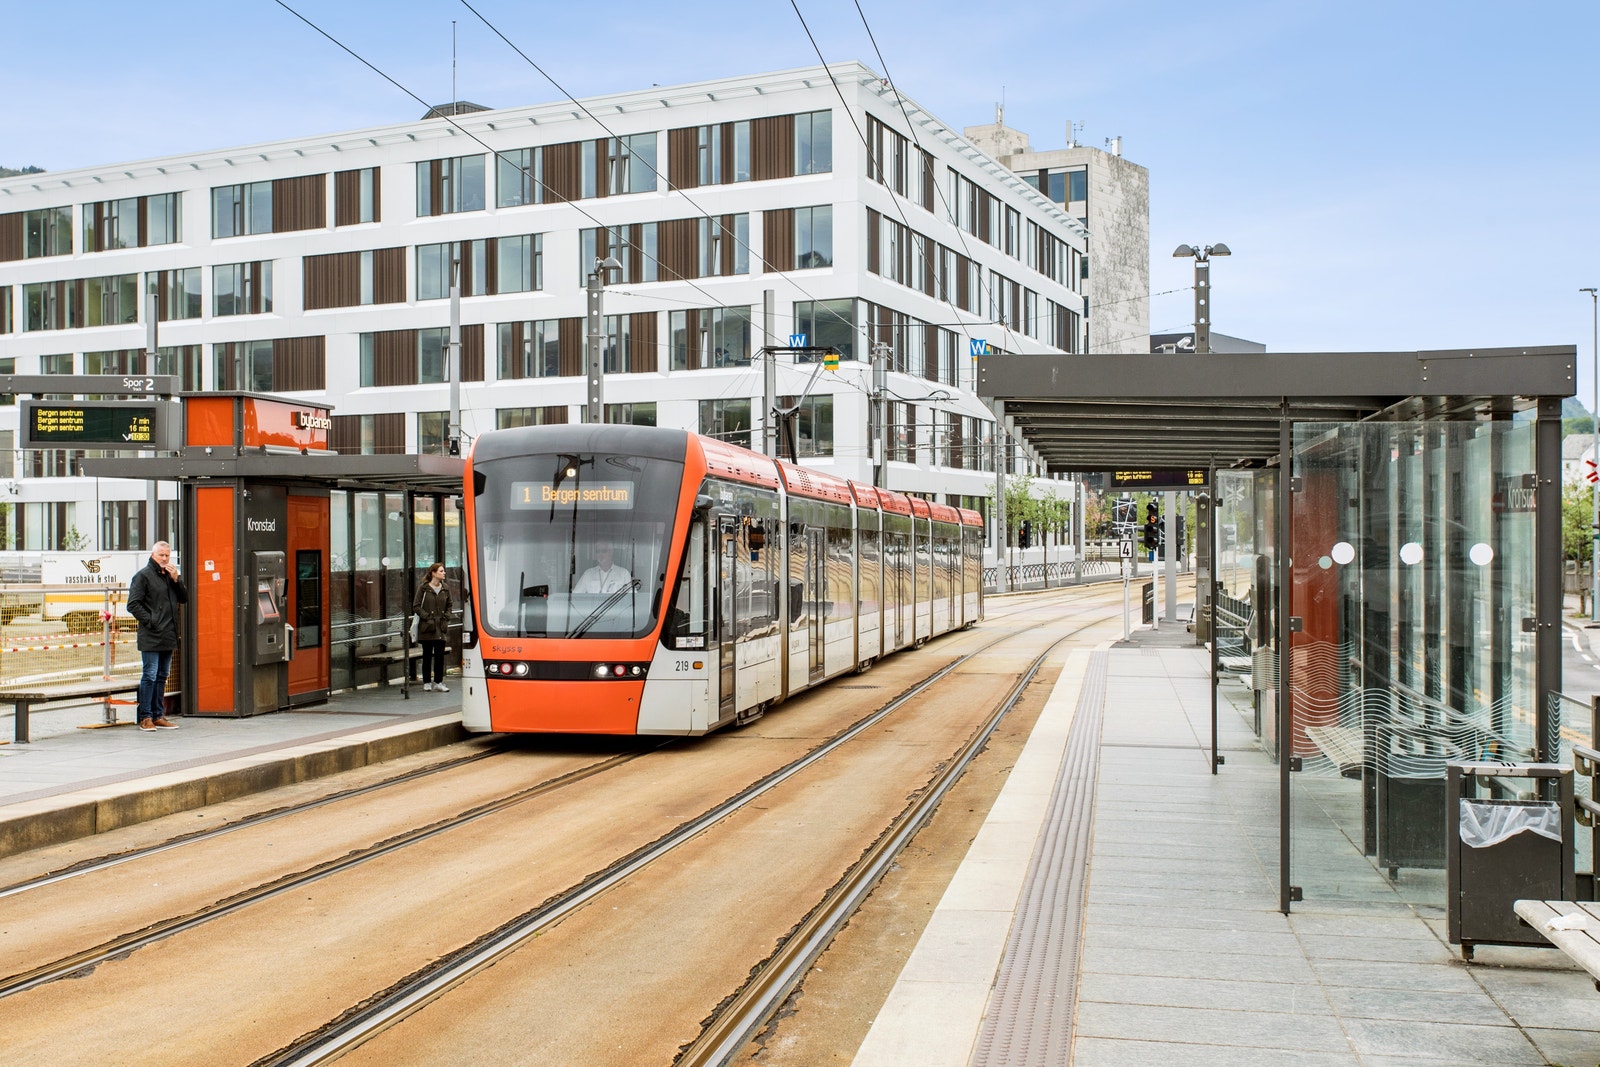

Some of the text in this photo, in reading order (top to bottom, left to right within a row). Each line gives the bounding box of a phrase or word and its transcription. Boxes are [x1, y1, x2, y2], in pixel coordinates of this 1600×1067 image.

[790, 335, 806, 348] W
[970, 340, 986, 355] W
[123, 378, 154, 391] Spor 2
[37, 409, 83, 418] Bergen sentrum
[37, 416, 58, 425] Bergen
[300, 411, 332, 430] bybanen
[37, 424, 58, 432] Bergen
[523, 485, 628, 504] 1 Bergen sentrum
[247, 518, 276, 531] Kronstad
[1122, 542, 1130, 556] 4
[65, 575, 95, 583] vassbakk
[97, 575, 102, 583] &
[492, 645, 516, 654] skyss
[675, 661, 689, 671] 219
